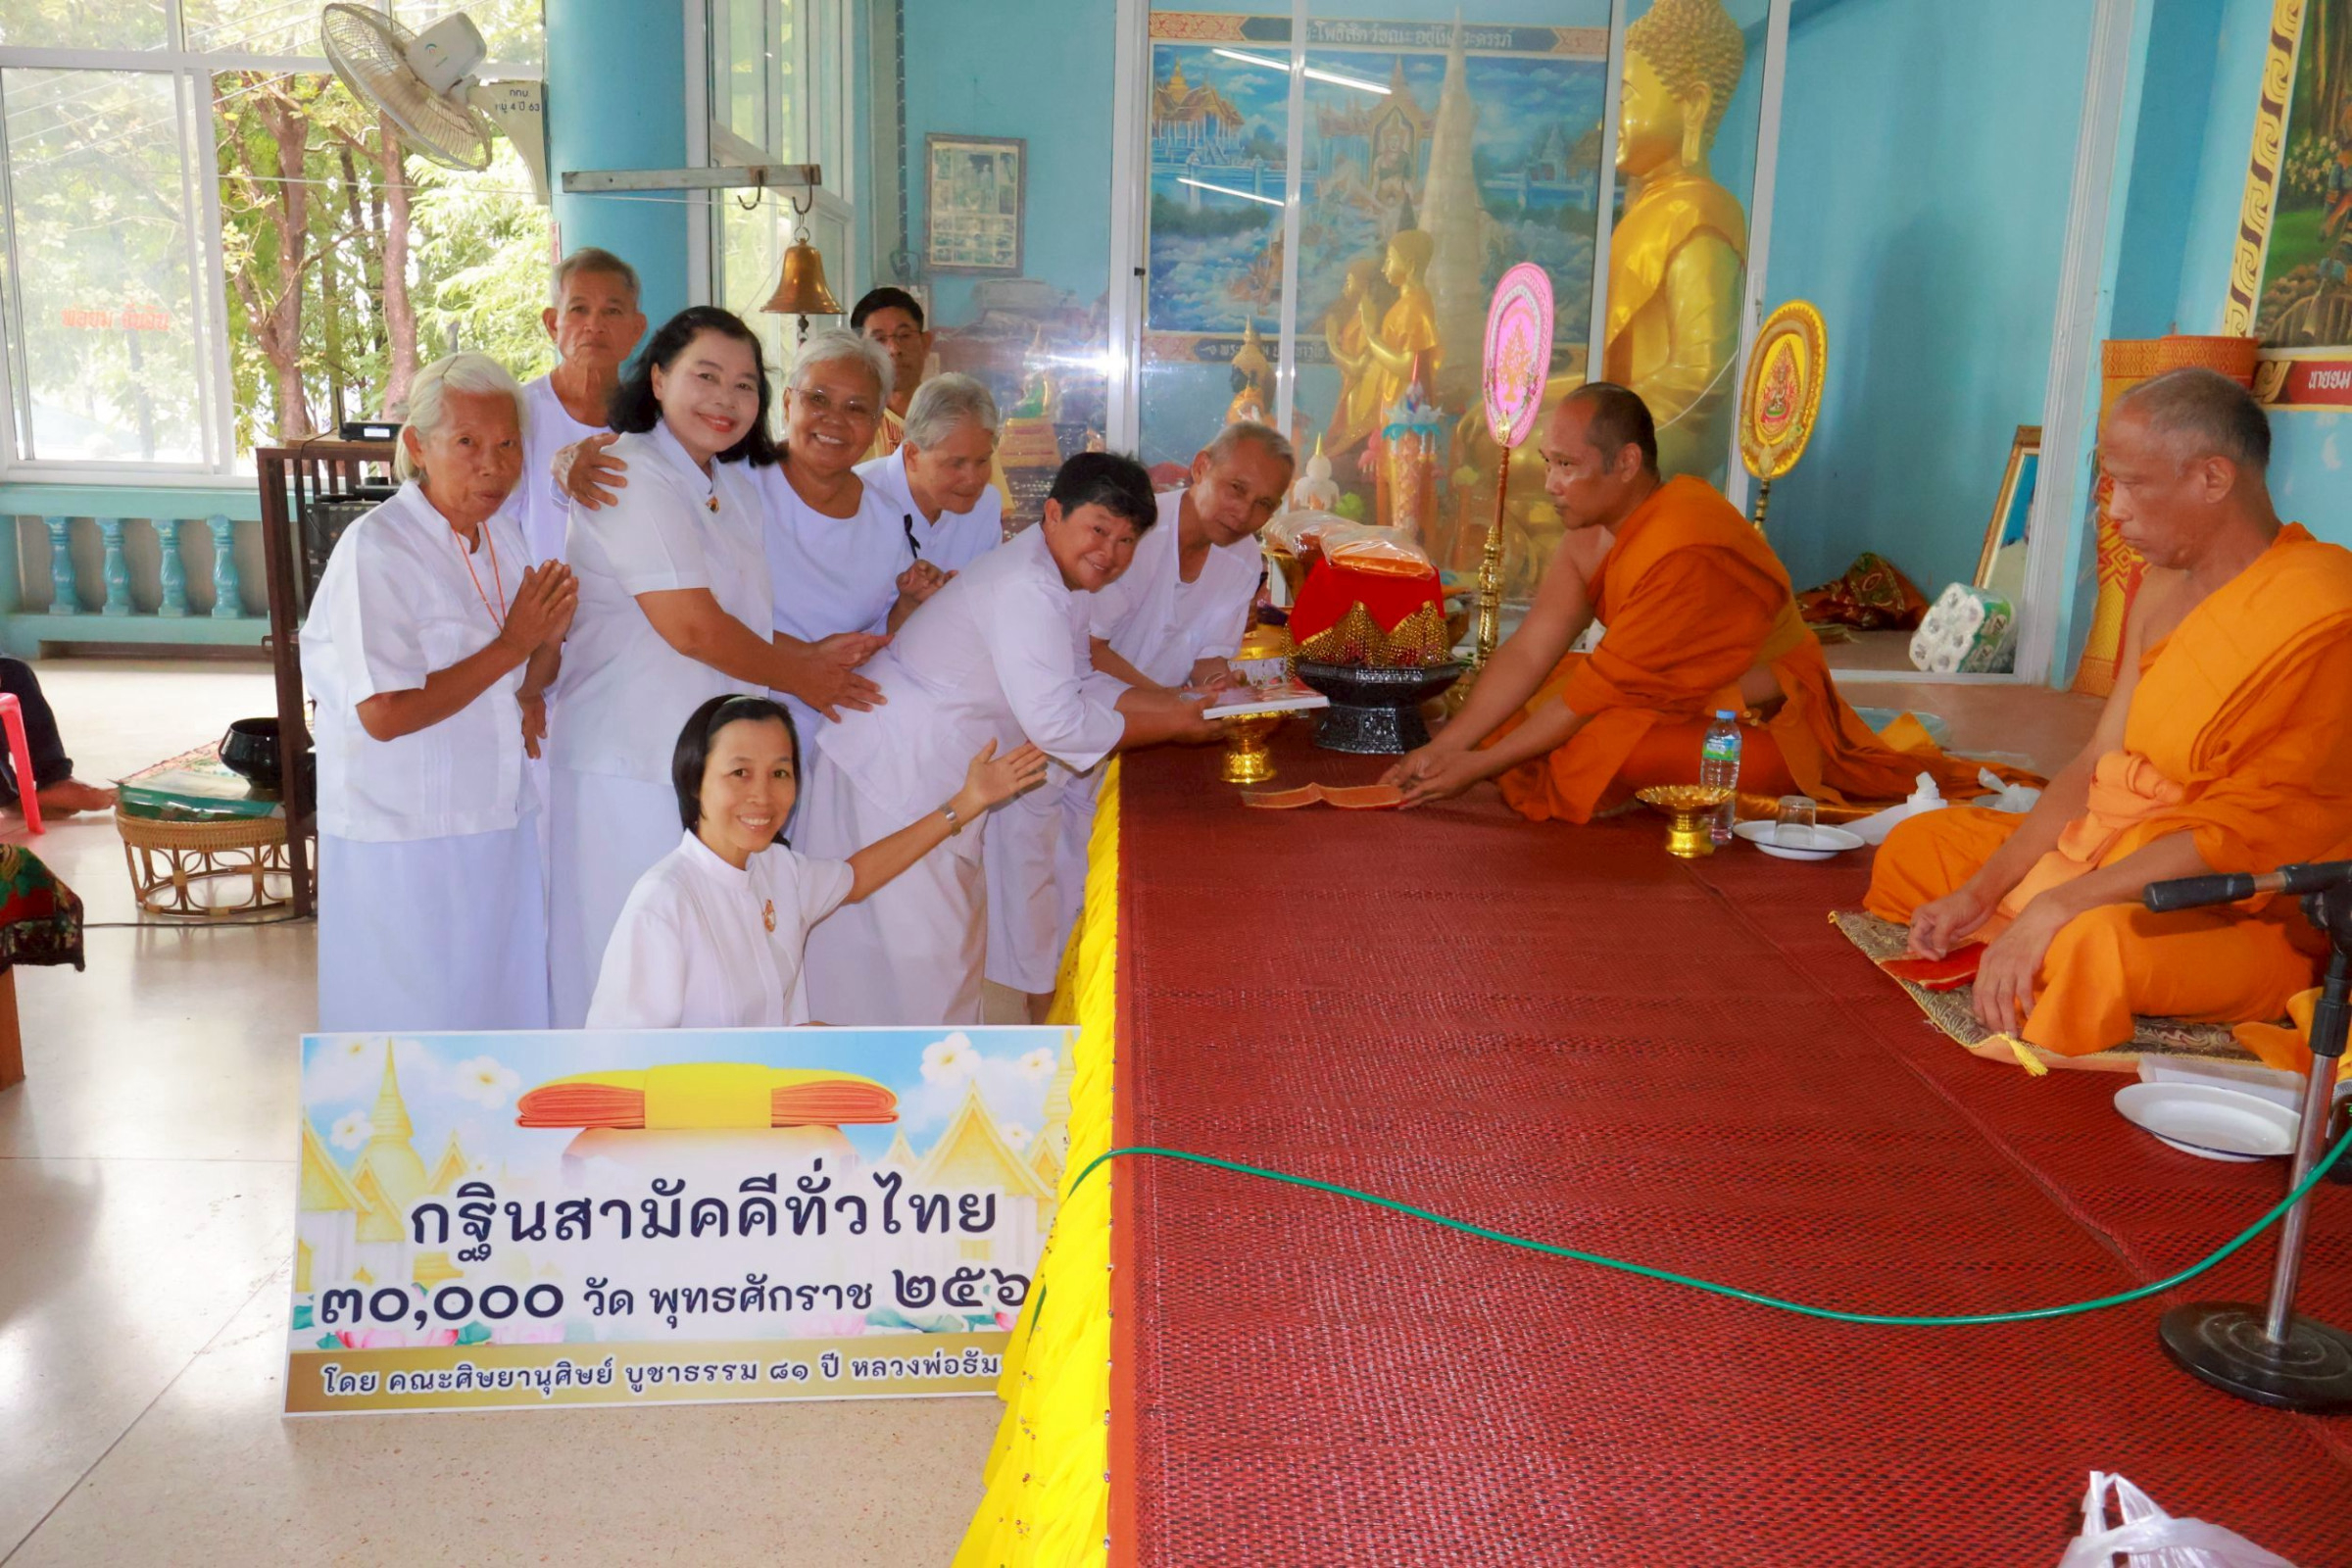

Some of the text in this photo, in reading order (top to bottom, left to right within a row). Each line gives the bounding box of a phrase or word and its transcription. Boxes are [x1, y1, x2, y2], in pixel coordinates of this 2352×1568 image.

[510, 102, 516, 111] 4
[528, 102, 541, 112] 63
[411, 1157, 997, 1262] กฐินสามัคคีทั่วไทย
[320, 1283, 564, 1330] ๓๐,๐๐๐
[583, 1276, 634, 1316] วัด
[649, 1273, 873, 1330] พุทธศักราช
[323, 1366, 375, 1393] โดย
[388, 1356, 613, 1396] คณะศิษยานุศิษย์
[625, 1362, 758, 1394] บูชาธรรม
[769, 1363, 808, 1381] ๘๑
[821, 1352, 841, 1379] ปี
